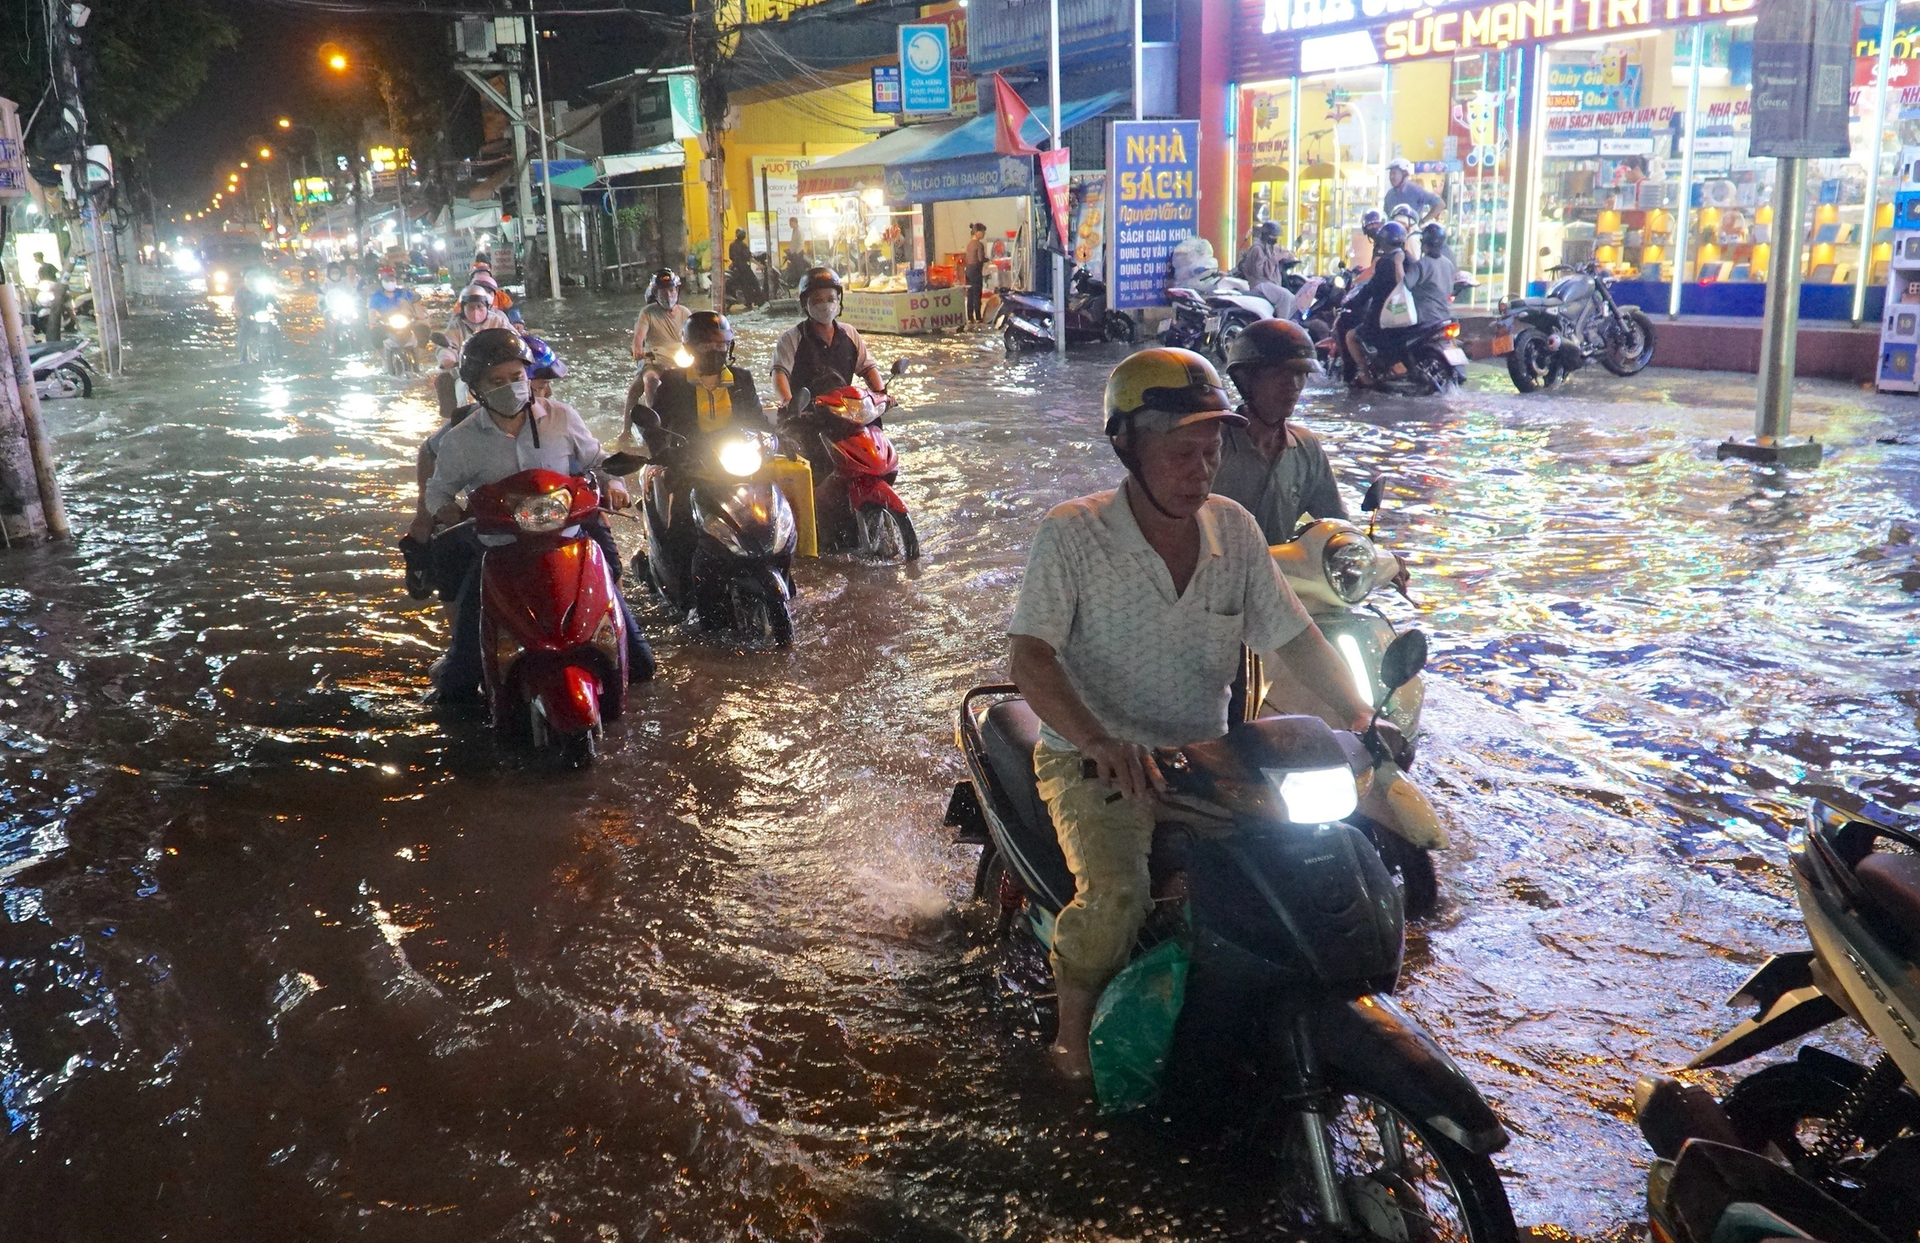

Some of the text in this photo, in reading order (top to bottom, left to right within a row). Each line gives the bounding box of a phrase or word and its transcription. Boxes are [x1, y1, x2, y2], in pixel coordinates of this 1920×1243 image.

[1384, 7, 1459, 60] SỨC
[1461, 0, 1574, 49] MẠNH
[683, 80, 695, 124] vistra 300
[1126, 128, 1187, 164] NHÀ
[960, 170, 998, 185] BAMBOO
[1121, 165, 1193, 200] SÁCH
[1120, 227, 1192, 243] SÁCH GIÁO KHOA
[1120, 247, 1140, 262] DỤNG
[1141, 246, 1152, 260] CỤ
[1152, 244, 1167, 258] VĂN
[1120, 261, 1172, 277] DỤNG CỤ HỌC
[910, 293, 952, 310] BÒ TƠ
[901, 313, 927, 330] TÂY
[930, 312, 963, 327] NINH
[1304, 853, 1335, 865] HONDA
